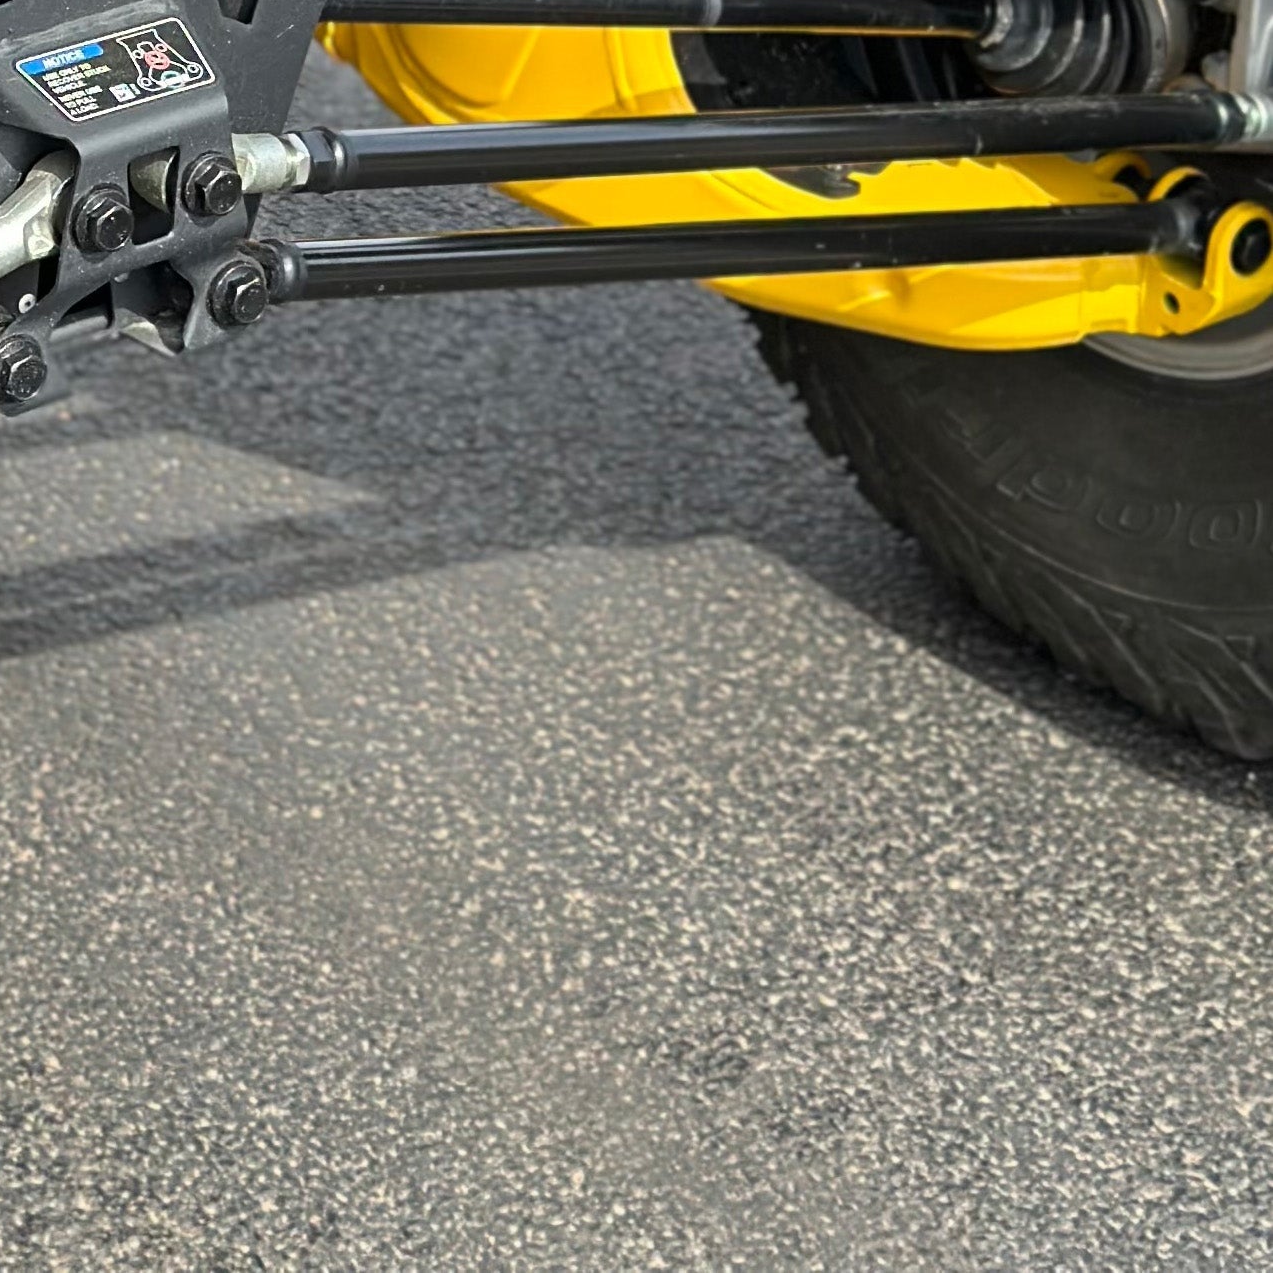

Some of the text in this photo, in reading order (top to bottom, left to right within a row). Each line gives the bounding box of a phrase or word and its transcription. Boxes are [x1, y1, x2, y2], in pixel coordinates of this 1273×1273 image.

[42, 49, 85, 70] NOTICE
[78, 62, 92, 71] TO
[47, 72, 85, 88] RECOVER
